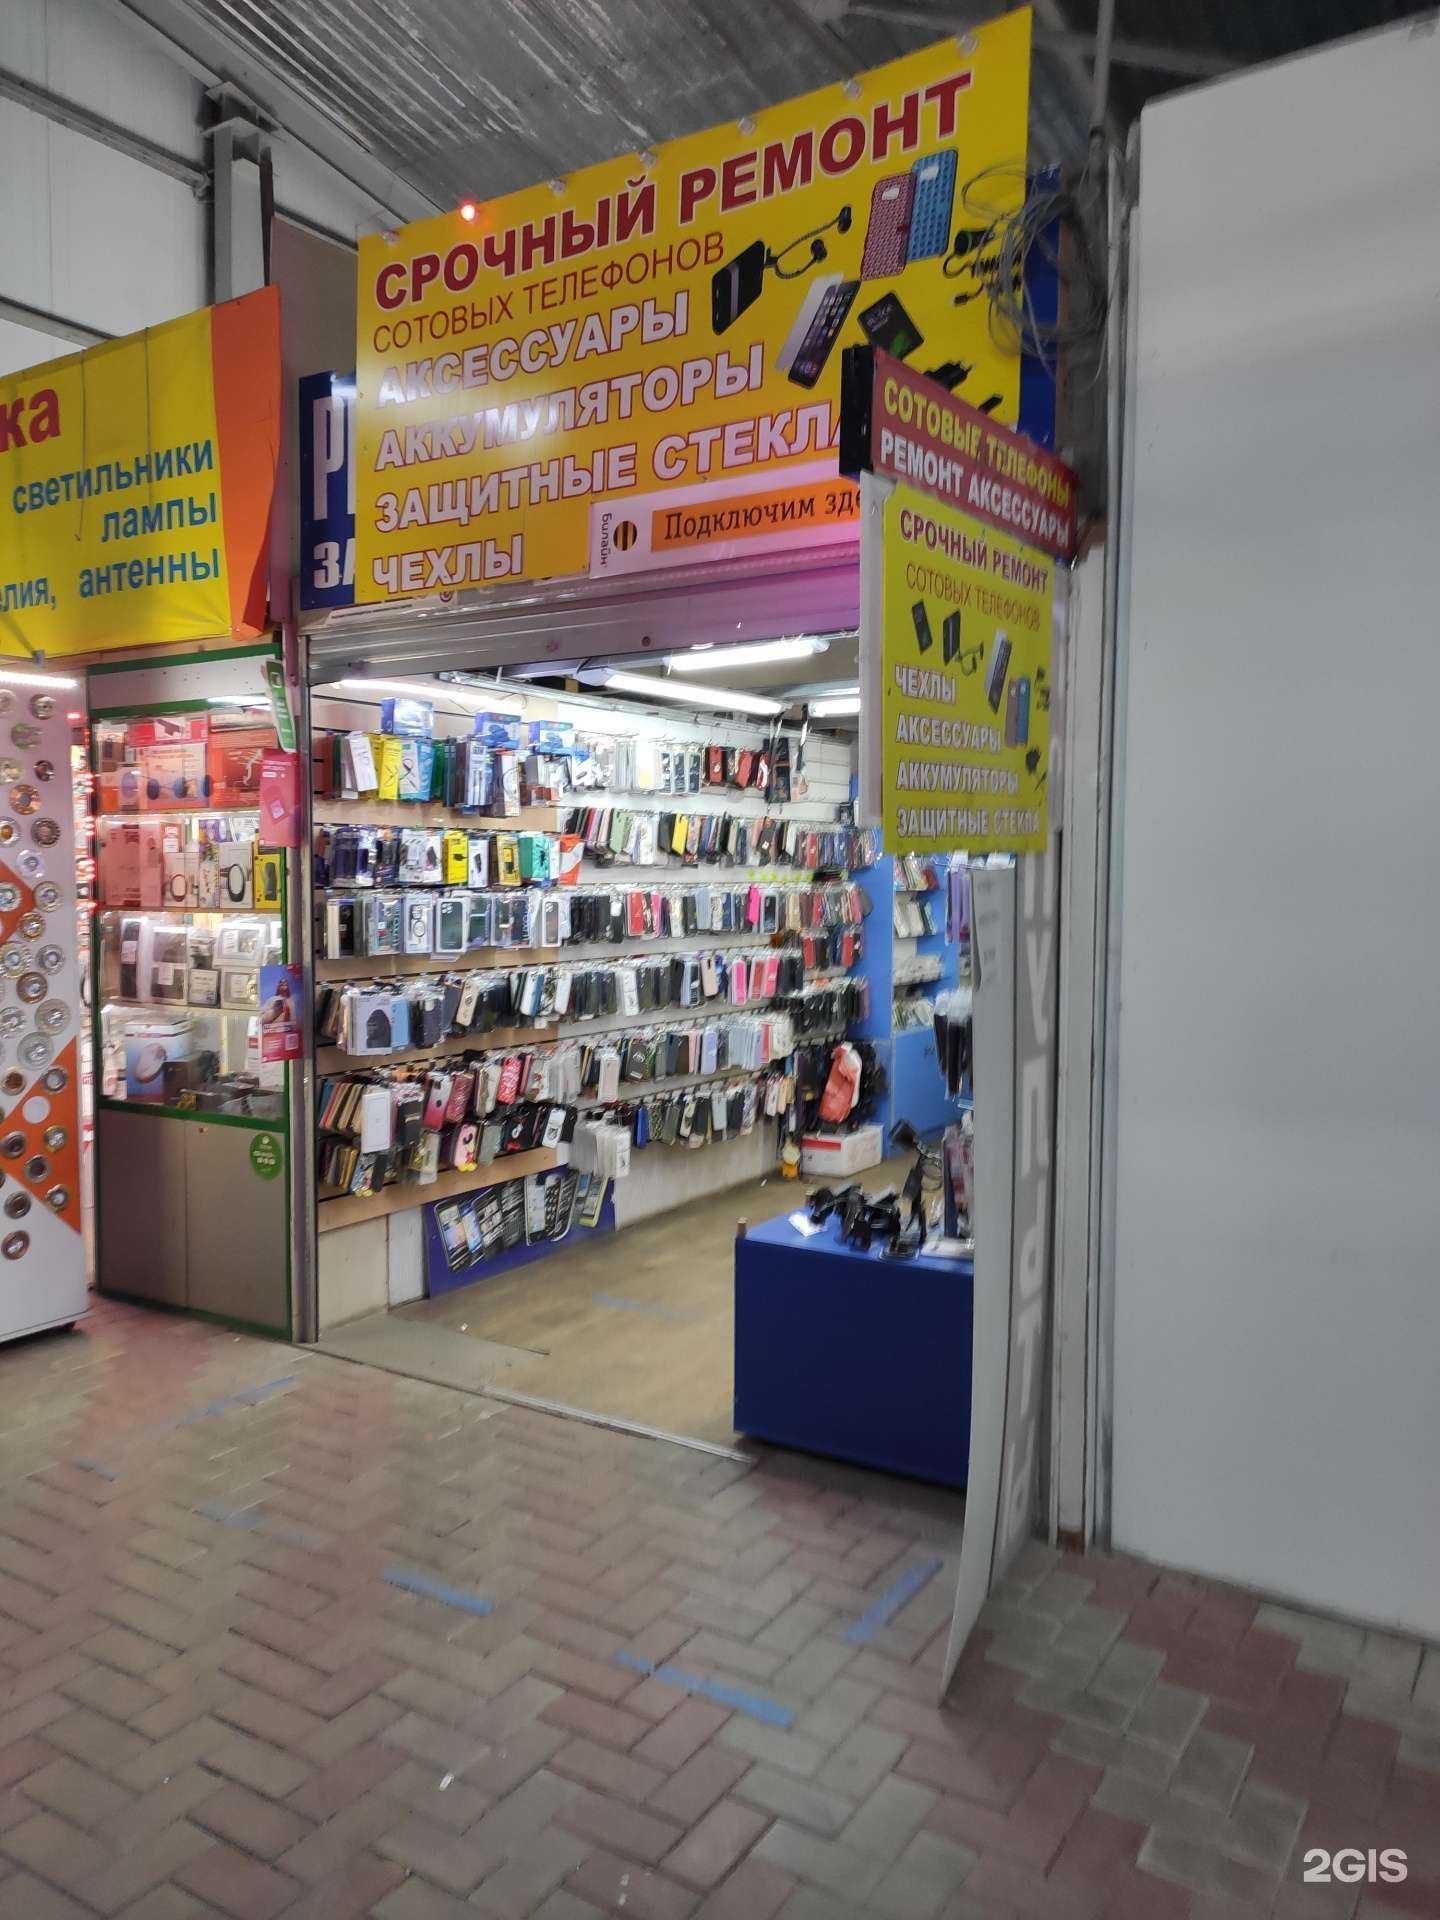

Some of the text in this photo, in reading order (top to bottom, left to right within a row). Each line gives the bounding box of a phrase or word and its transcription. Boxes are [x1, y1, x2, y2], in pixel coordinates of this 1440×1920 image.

[375, 71, 973, 311] СРОЧНЫЙ РЕМОНТ
[373, 231, 725, 354] СОТОВЫХ ТЕЛЕФОНОВ
[377, 290, 690, 409] АКСЕССУАРЫ
[375, 344, 765, 473] АККУМУЛЯТОРЫ
[12, 440, 214, 515] светильники
[374, 401, 840, 533] ЗАЩИТНЫЕ СТЕКЛ
[880, 428, 1070, 548] РЕМОНТ АКСЕССУАРЫ
[100, 493, 217, 544] лампы
[601, 512, 612, 568] билайн
[664, 496, 815, 541] Подключим
[78, 549, 219, 599] антенны
[372, 534, 523, 594] ЧЕХЛЫ
[899, 508, 1049, 595] СРОЧНЫЙ РЕМОНТ
[905, 562, 973, 609] СОТОВЫХ
[895, 663, 957, 705] ЧЕХЛЫ
[895, 713, 1001, 755] АКСЕССУАРЫ
[896, 761, 1019, 796] АККУМУЛЯТОРЫ
[896, 807, 989, 840] ЗАЩИТНЫЕ
